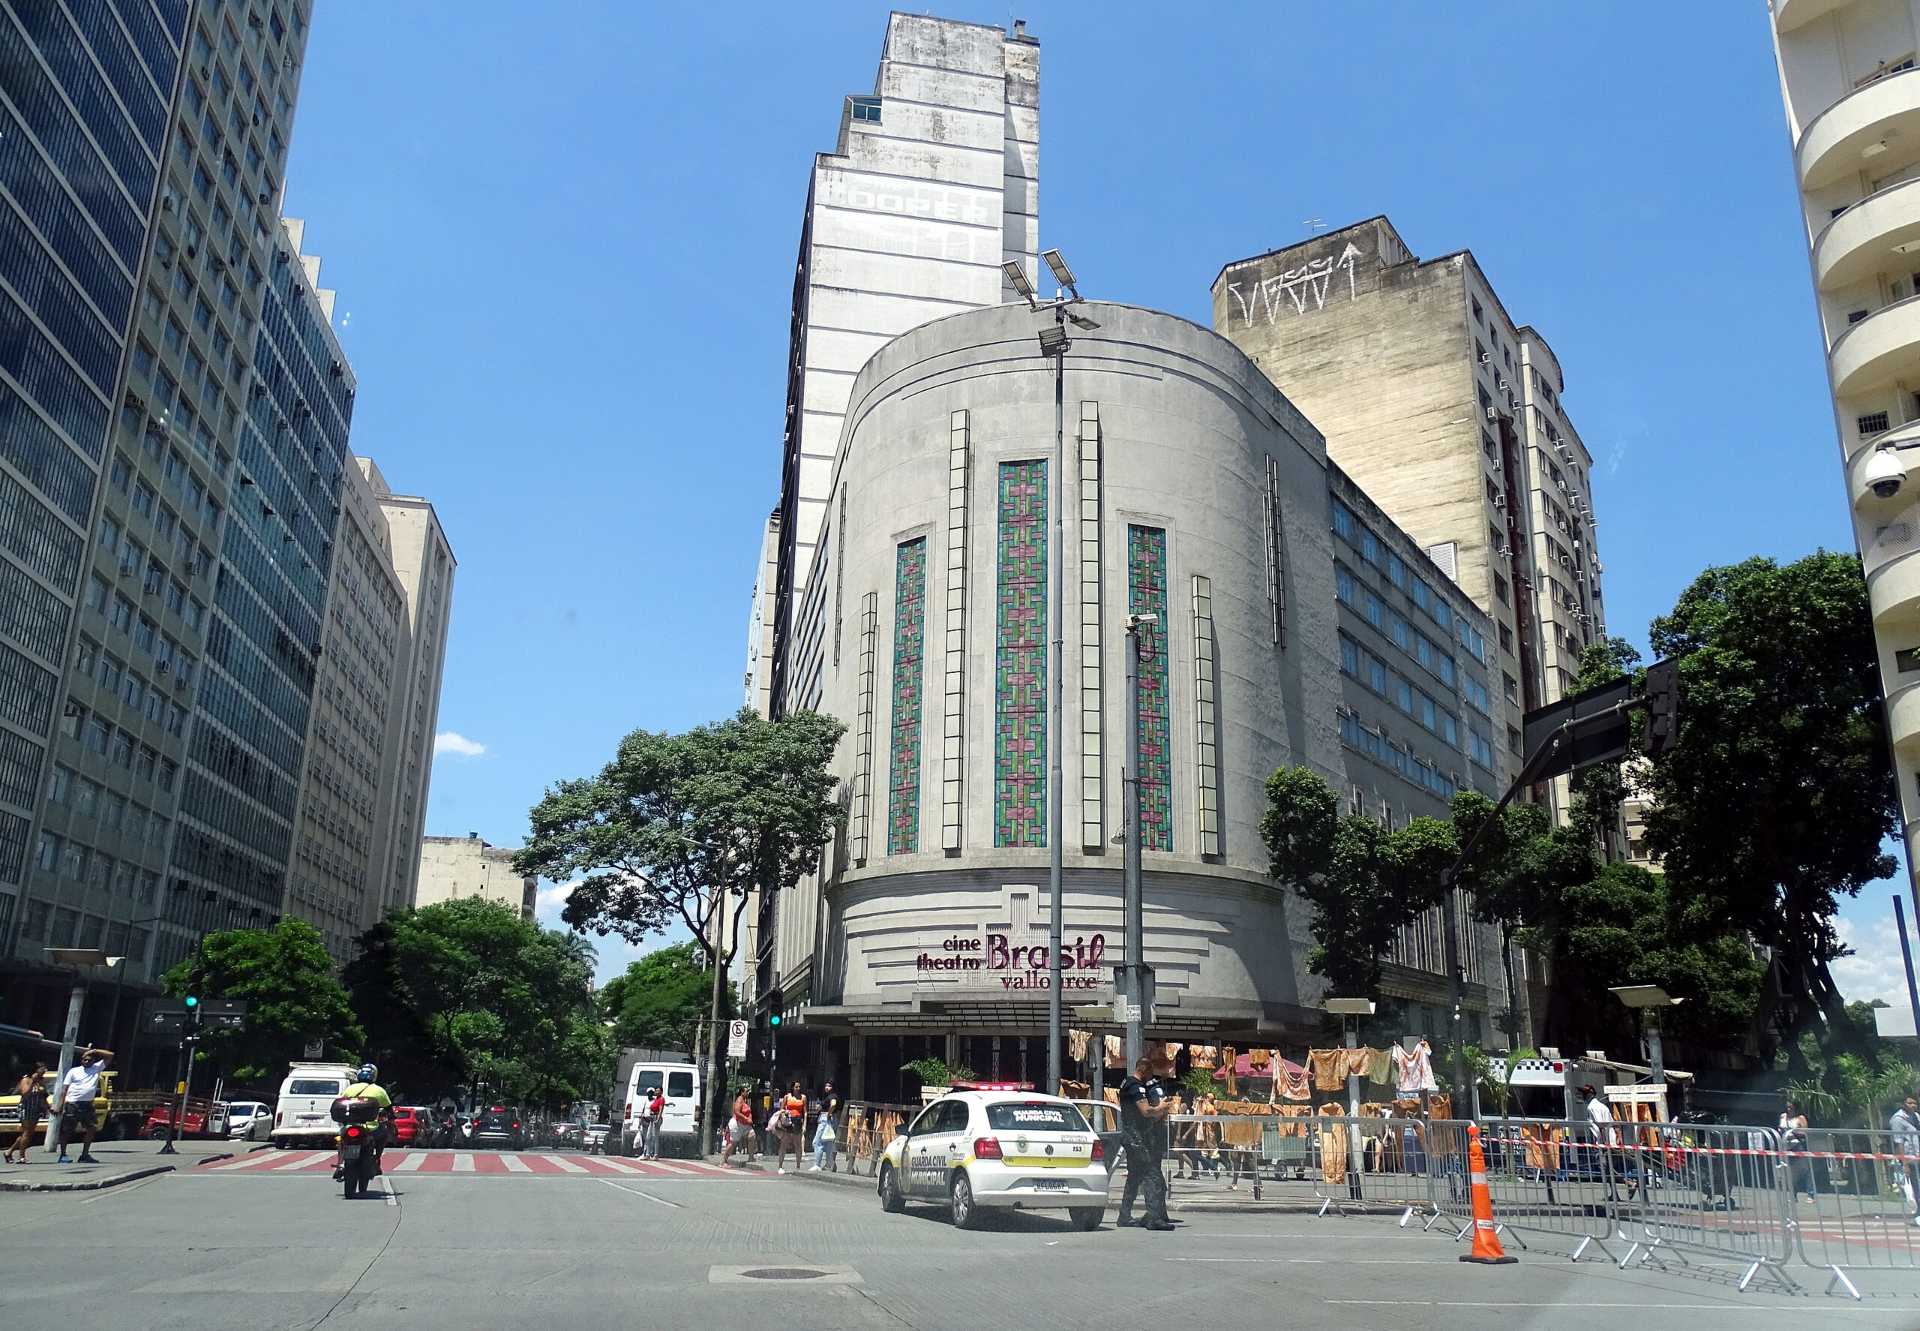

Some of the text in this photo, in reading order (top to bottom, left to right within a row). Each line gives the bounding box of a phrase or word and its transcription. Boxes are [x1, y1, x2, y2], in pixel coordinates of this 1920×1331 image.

[986, 933, 1105, 969] Brasil
[917, 953, 980, 970] theatro
[1015, 1113, 1064, 1122] MUNICIPAL
[912, 1156, 932, 1166] GUARDA
[933, 1156, 947, 1166] CIVIL
[911, 1170, 946, 1185] MUNICIPAL
